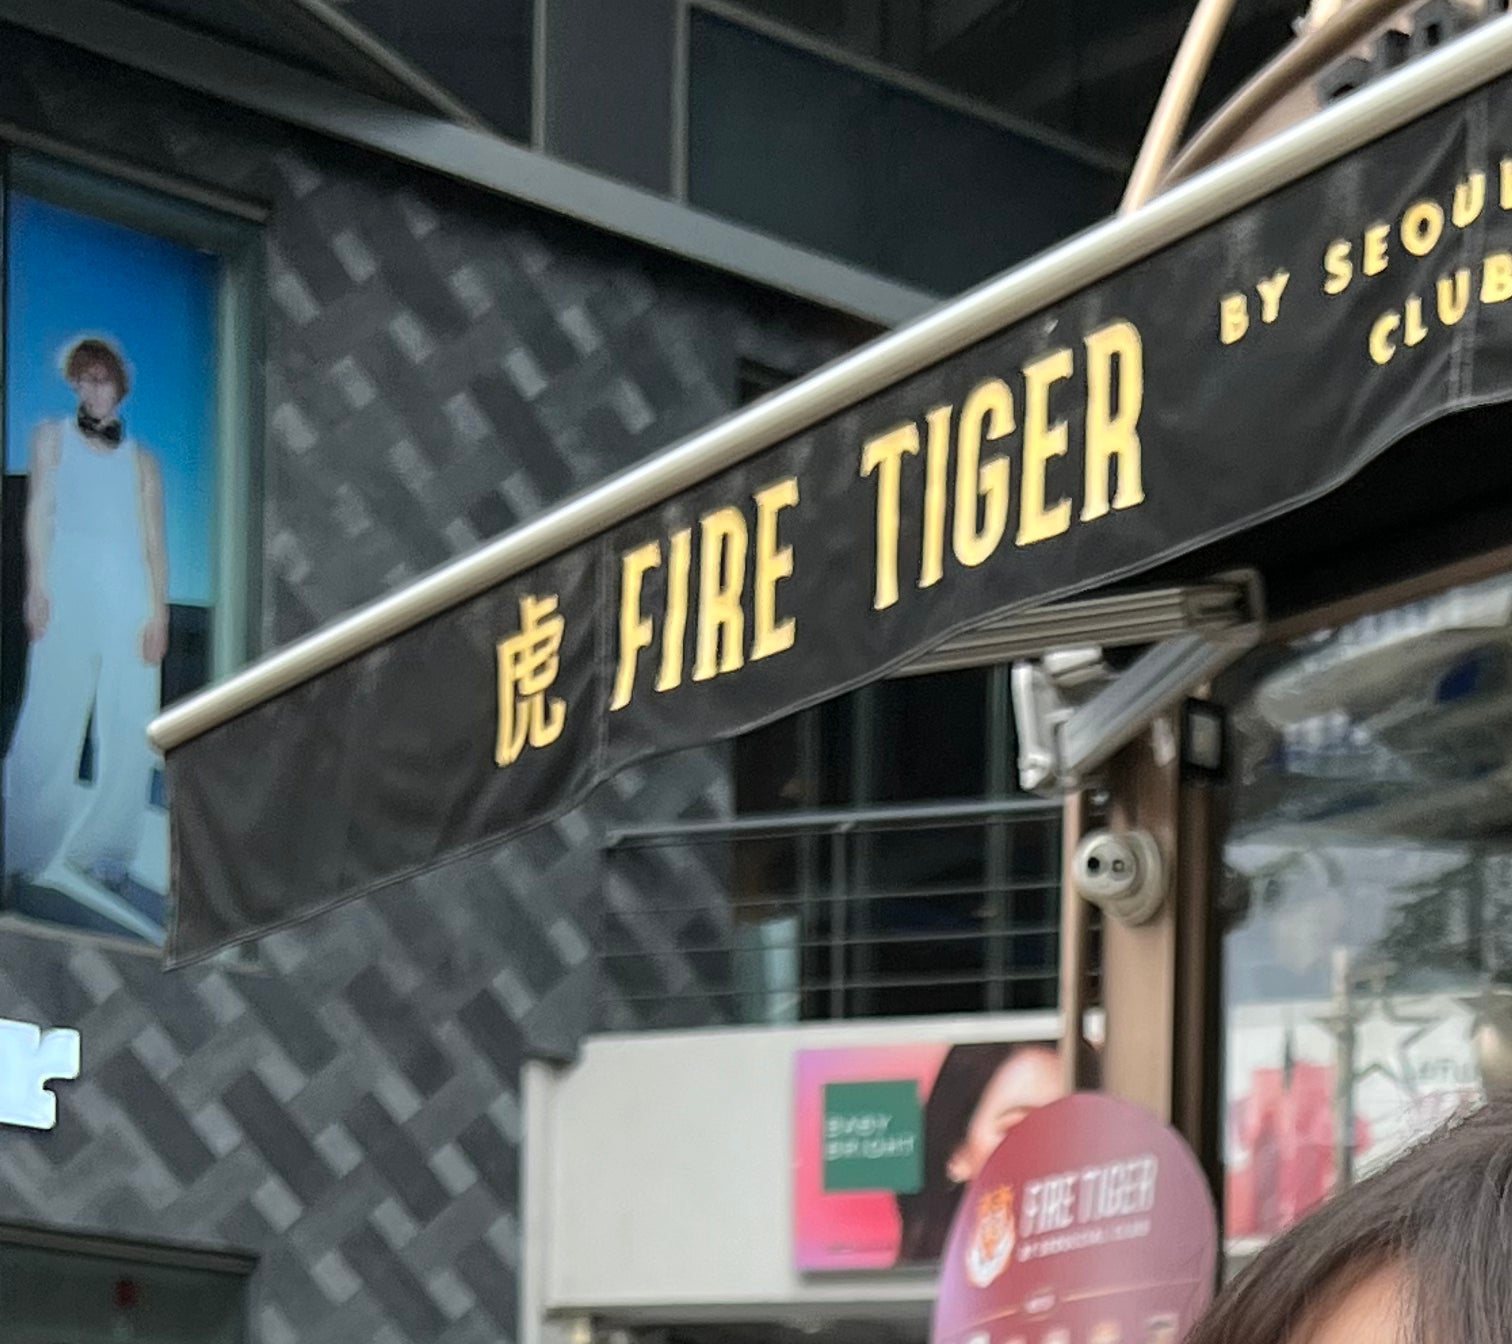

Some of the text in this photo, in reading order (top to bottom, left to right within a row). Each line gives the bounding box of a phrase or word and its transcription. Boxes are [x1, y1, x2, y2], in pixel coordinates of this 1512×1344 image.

[1220, 268, 1290, 345] BY
[609, 320, 1146, 712] FIRE TIGER
[495, 593, 567, 768] 虎
[1019, 1153, 1158, 1239] FIRE TIGER
